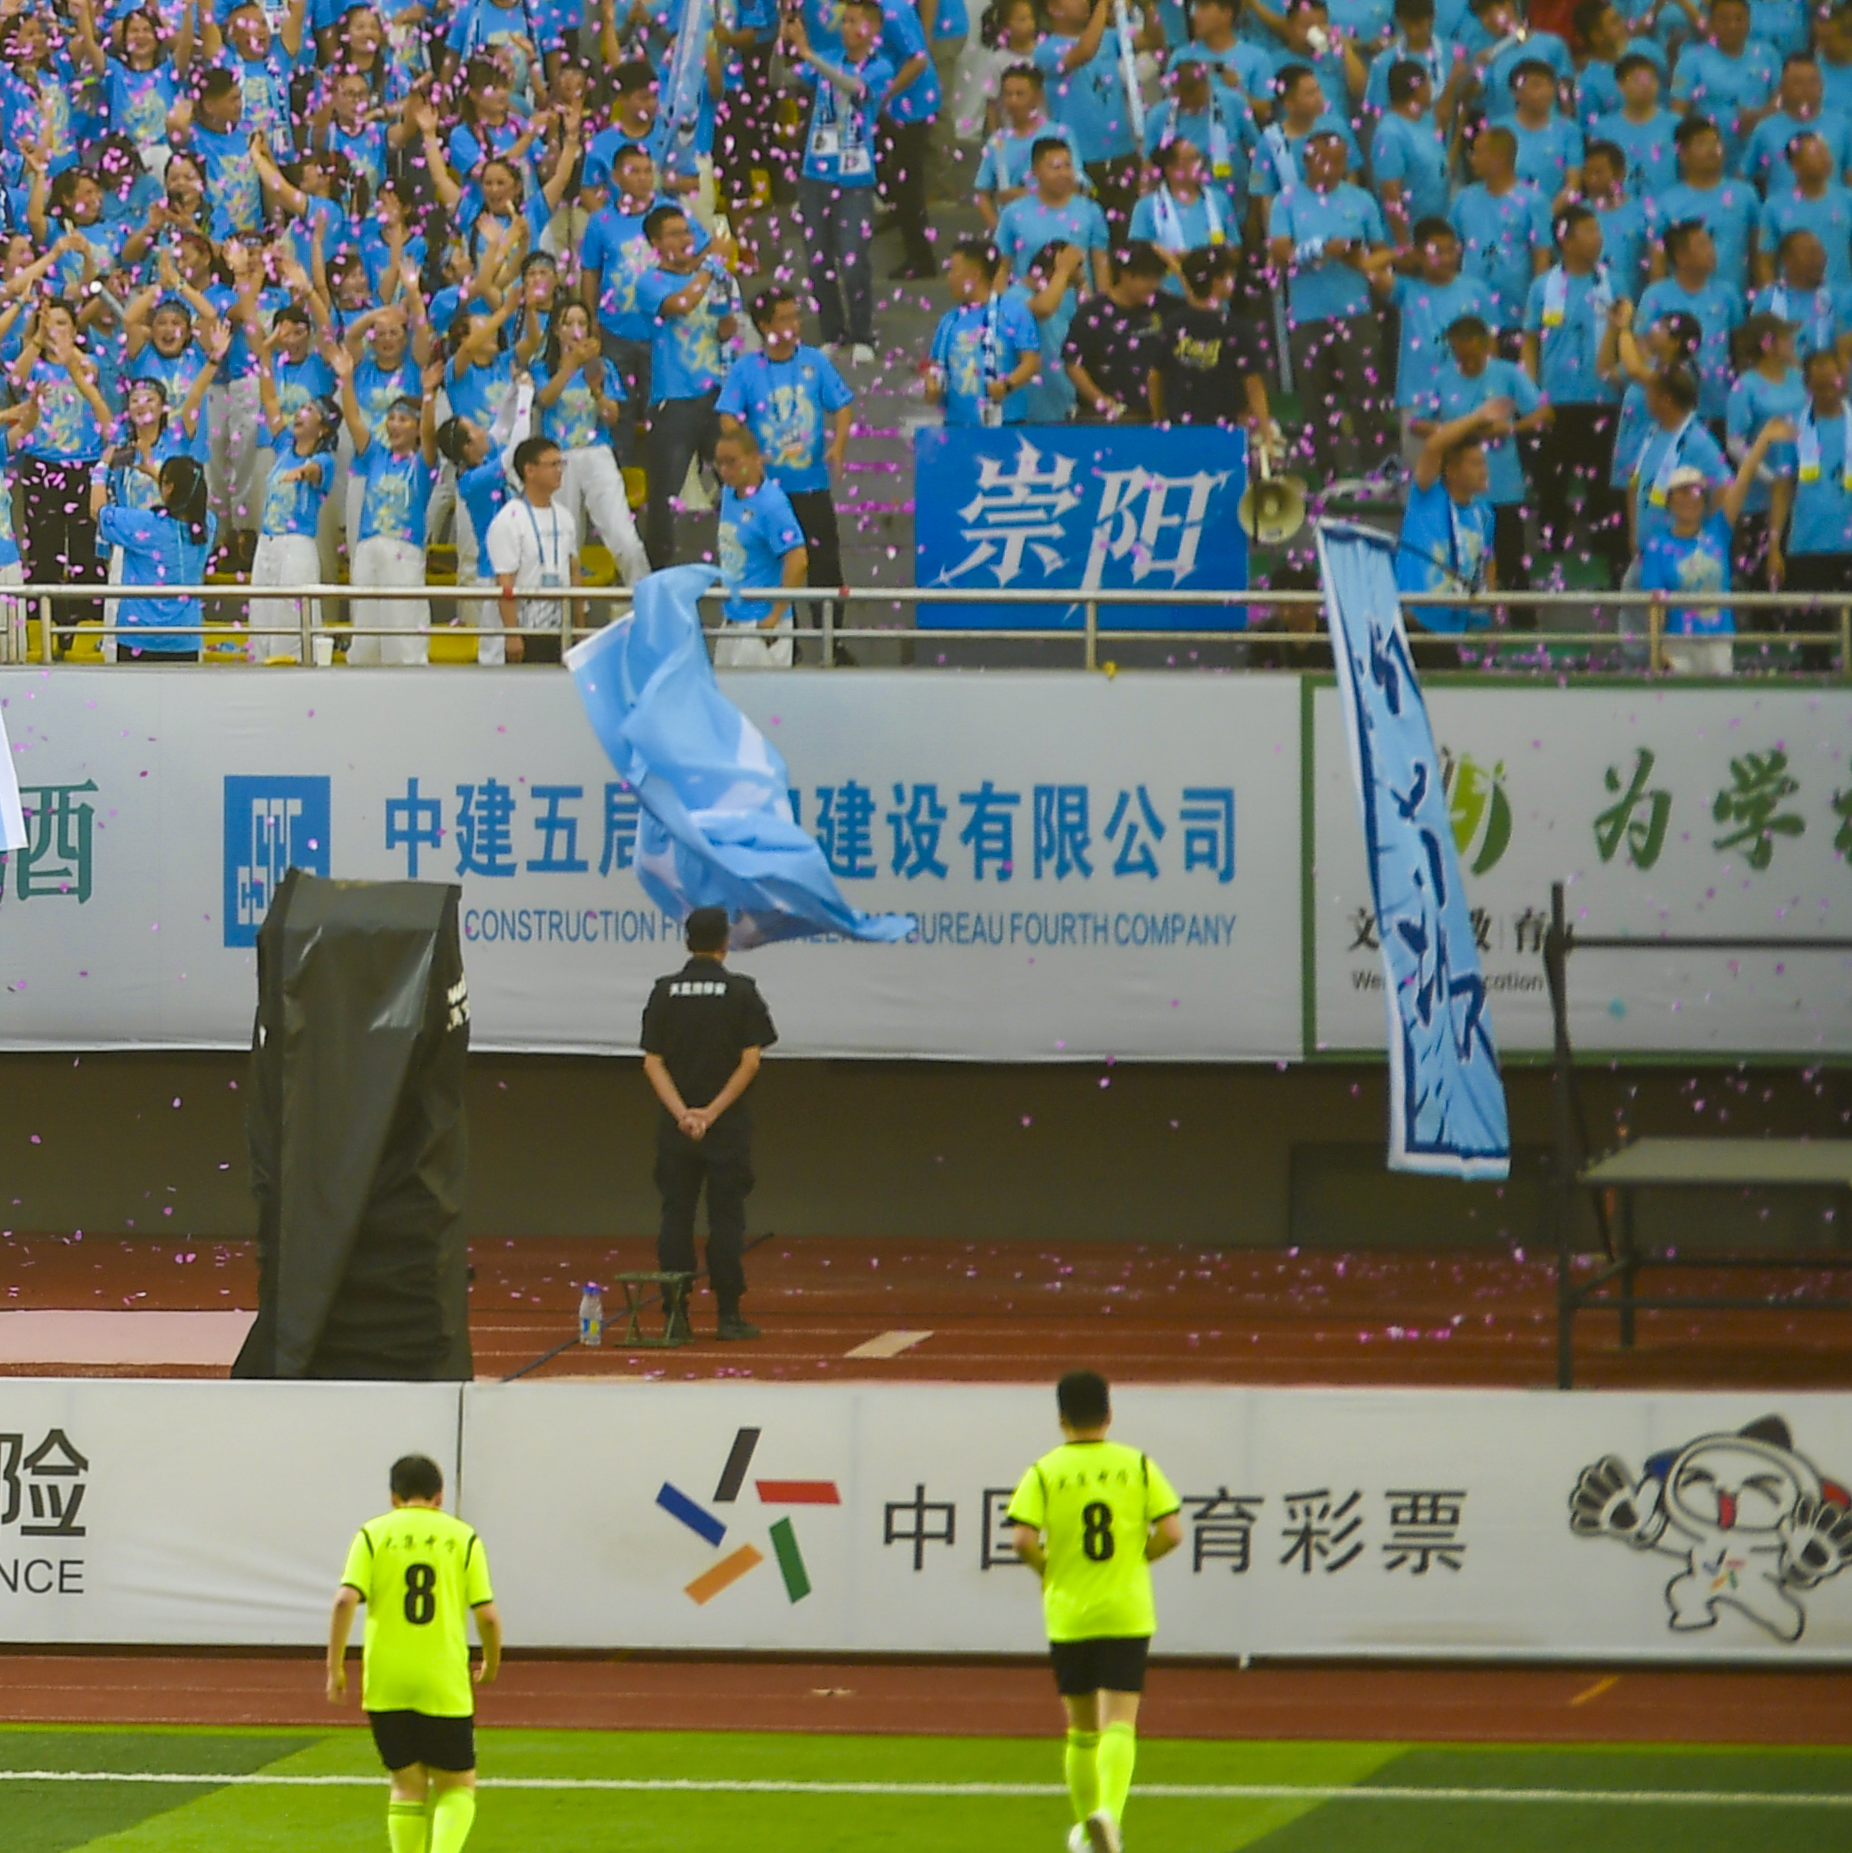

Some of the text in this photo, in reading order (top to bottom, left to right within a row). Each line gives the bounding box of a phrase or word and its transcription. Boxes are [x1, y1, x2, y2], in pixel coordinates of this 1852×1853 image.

[937, 434, 1233, 620] 崇阳
[384, 776, 1238, 885] 中建五局建设有限公司
[1594, 748, 1852, 871] 为学
[465, 909, 656, 942] CONSTRUCTION
[1010, 911, 1110, 945] FOURTH
[1114, 912, 1237, 947] COMPANY
[883, 1483, 1469, 1575] 中育彩票
[1081, 1500, 1115, 1562] 8
[403, 1563, 437, 1625] 8
